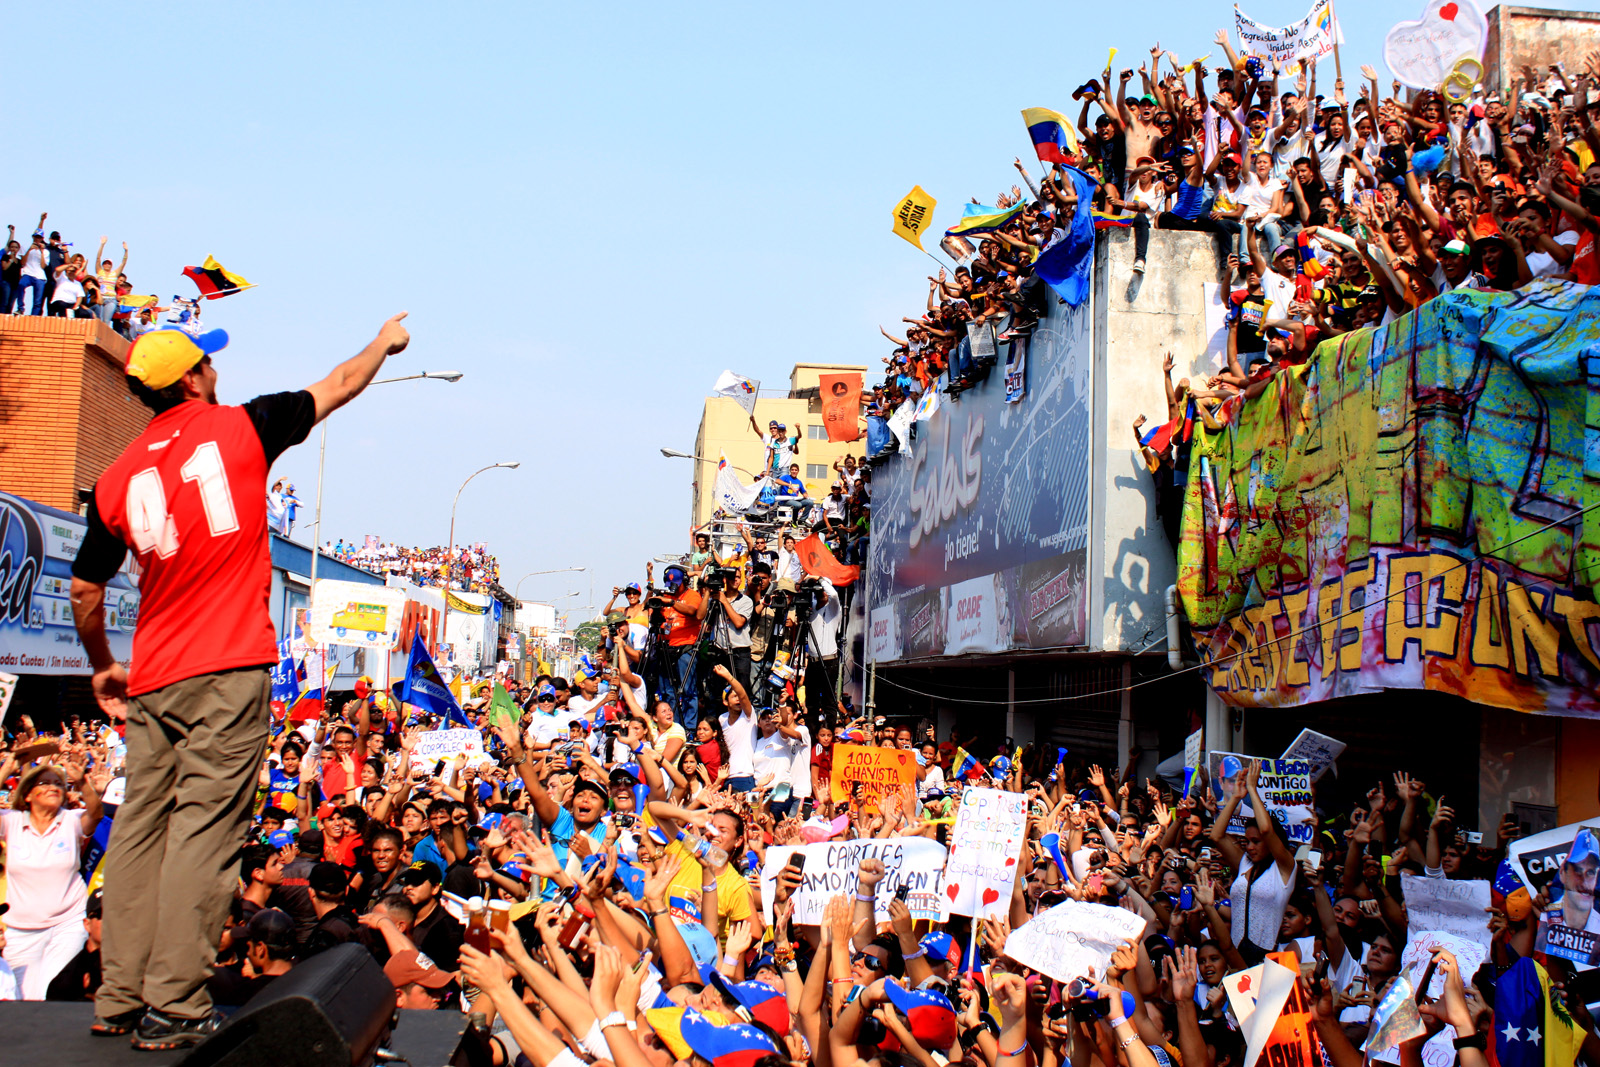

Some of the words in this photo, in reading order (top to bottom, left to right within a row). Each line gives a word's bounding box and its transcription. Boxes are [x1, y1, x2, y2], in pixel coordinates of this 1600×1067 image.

[126, 441, 240, 561] 41
[0, 652, 18, 665] odas
[20, 653, 45, 667] Cuotas
[51, 655, 61, 668] Sin
[62, 656, 82, 668] Inicial
[464, 743, 475, 751] NO
[847, 751, 881, 766] 100%
[843, 766, 900, 783] CHAVISTA
[684, 902, 697, 916] UN
[1547, 929, 1595, 954] CAPRILES
